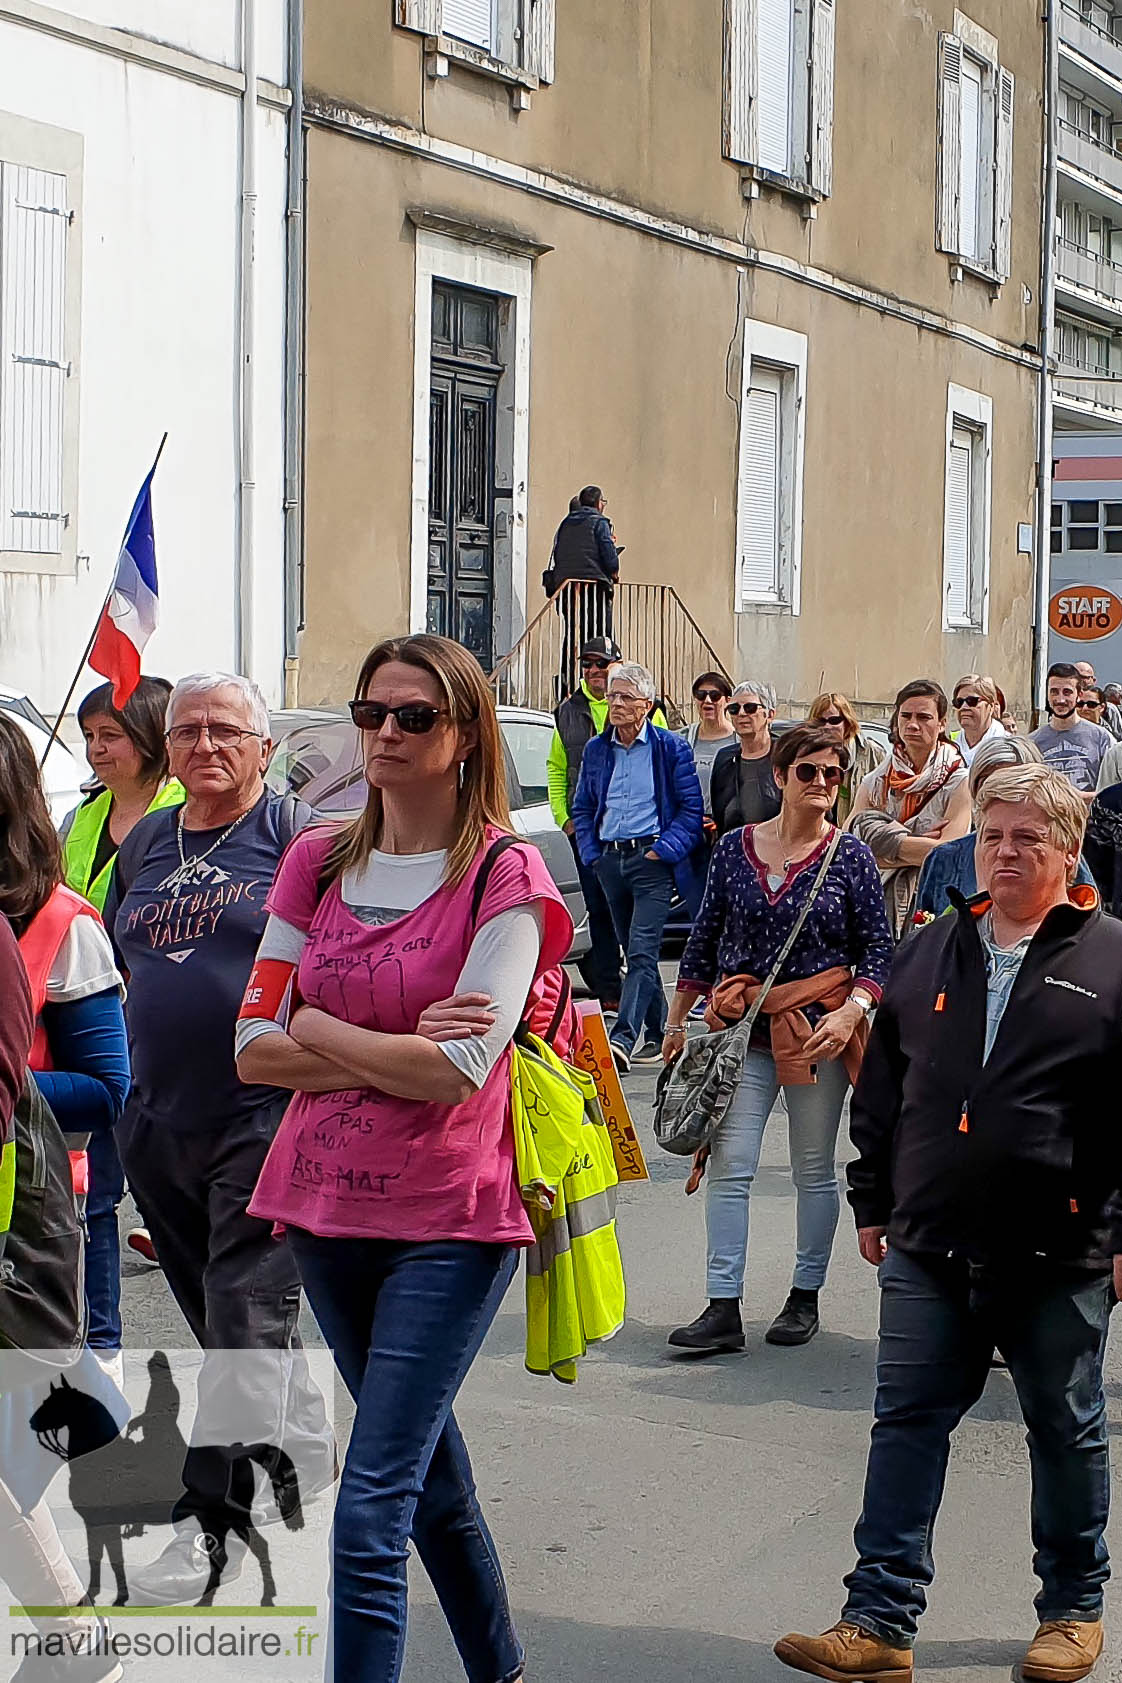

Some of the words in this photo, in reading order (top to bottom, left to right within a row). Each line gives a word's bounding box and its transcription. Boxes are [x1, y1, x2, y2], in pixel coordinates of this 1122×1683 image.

[1058, 597, 1111, 614] STAFF
[1058, 614, 1111, 629] AUTO
[125, 880, 260, 931] MONTBLANC
[149, 909, 223, 949] VALLEY
[381, 942, 396, 958] 2
[401, 937, 433, 953] ans
[339, 1113, 375, 1134] PAS
[313, 1131, 352, 1150] MON
